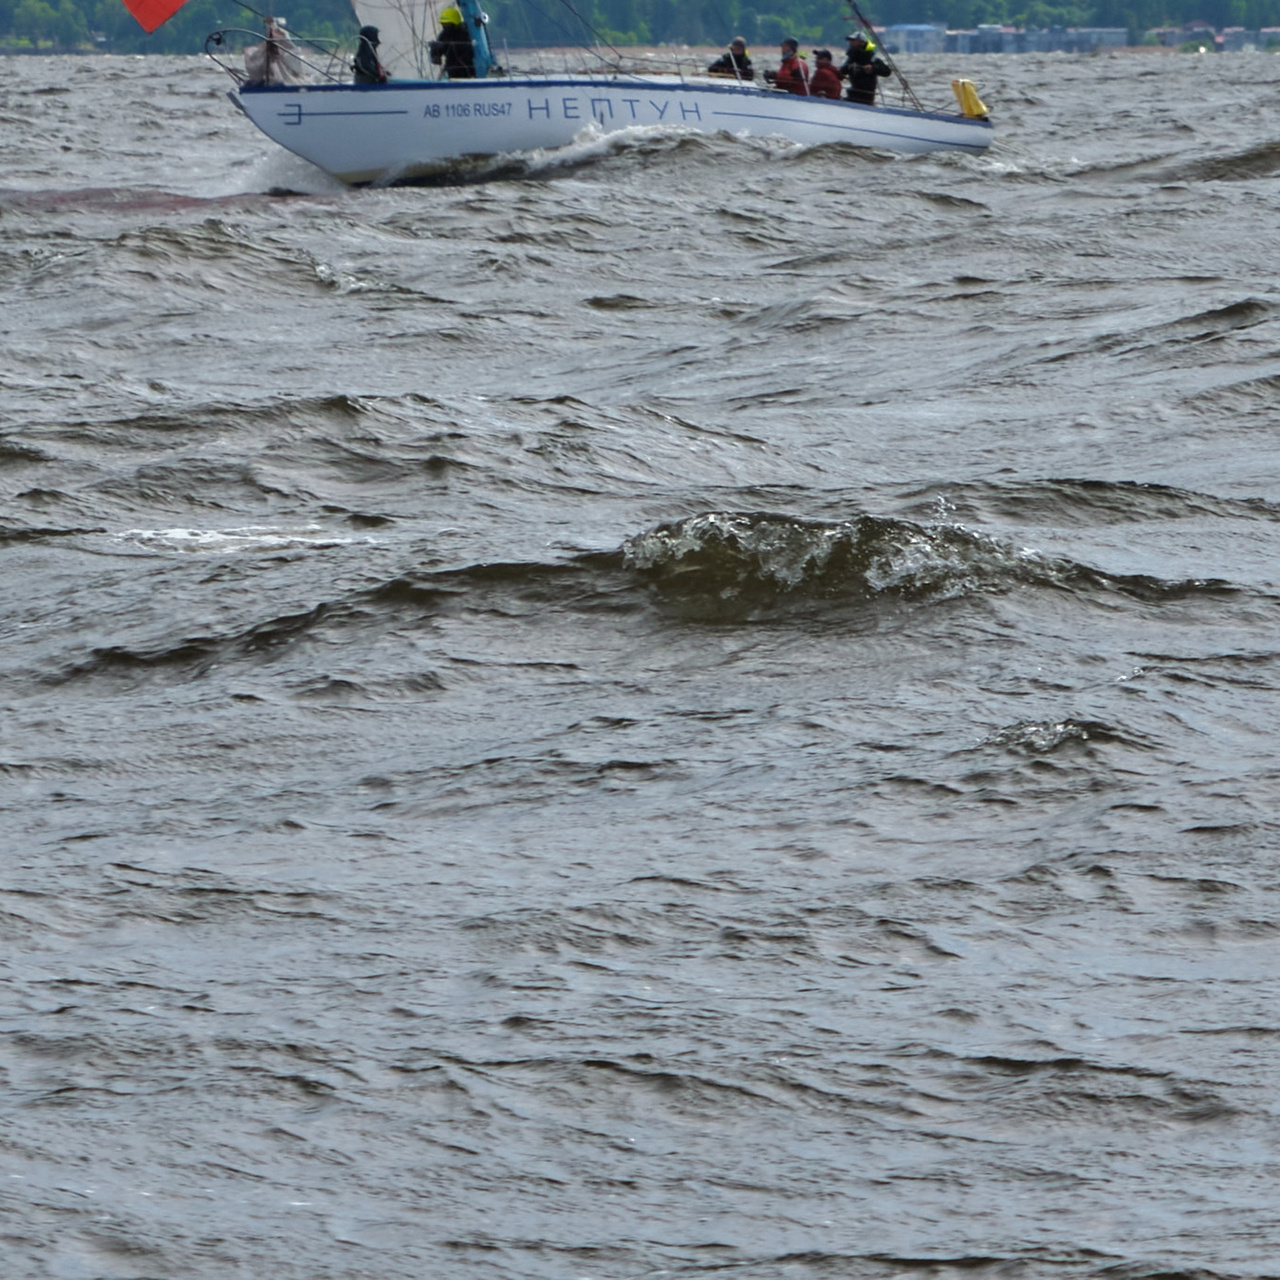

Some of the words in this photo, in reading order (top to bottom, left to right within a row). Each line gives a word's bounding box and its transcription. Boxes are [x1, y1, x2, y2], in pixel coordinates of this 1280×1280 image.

[445, 103, 471, 117] 1106
[473, 102, 512, 116] RUS47
[528, 97, 701, 121] НЕПТУН
